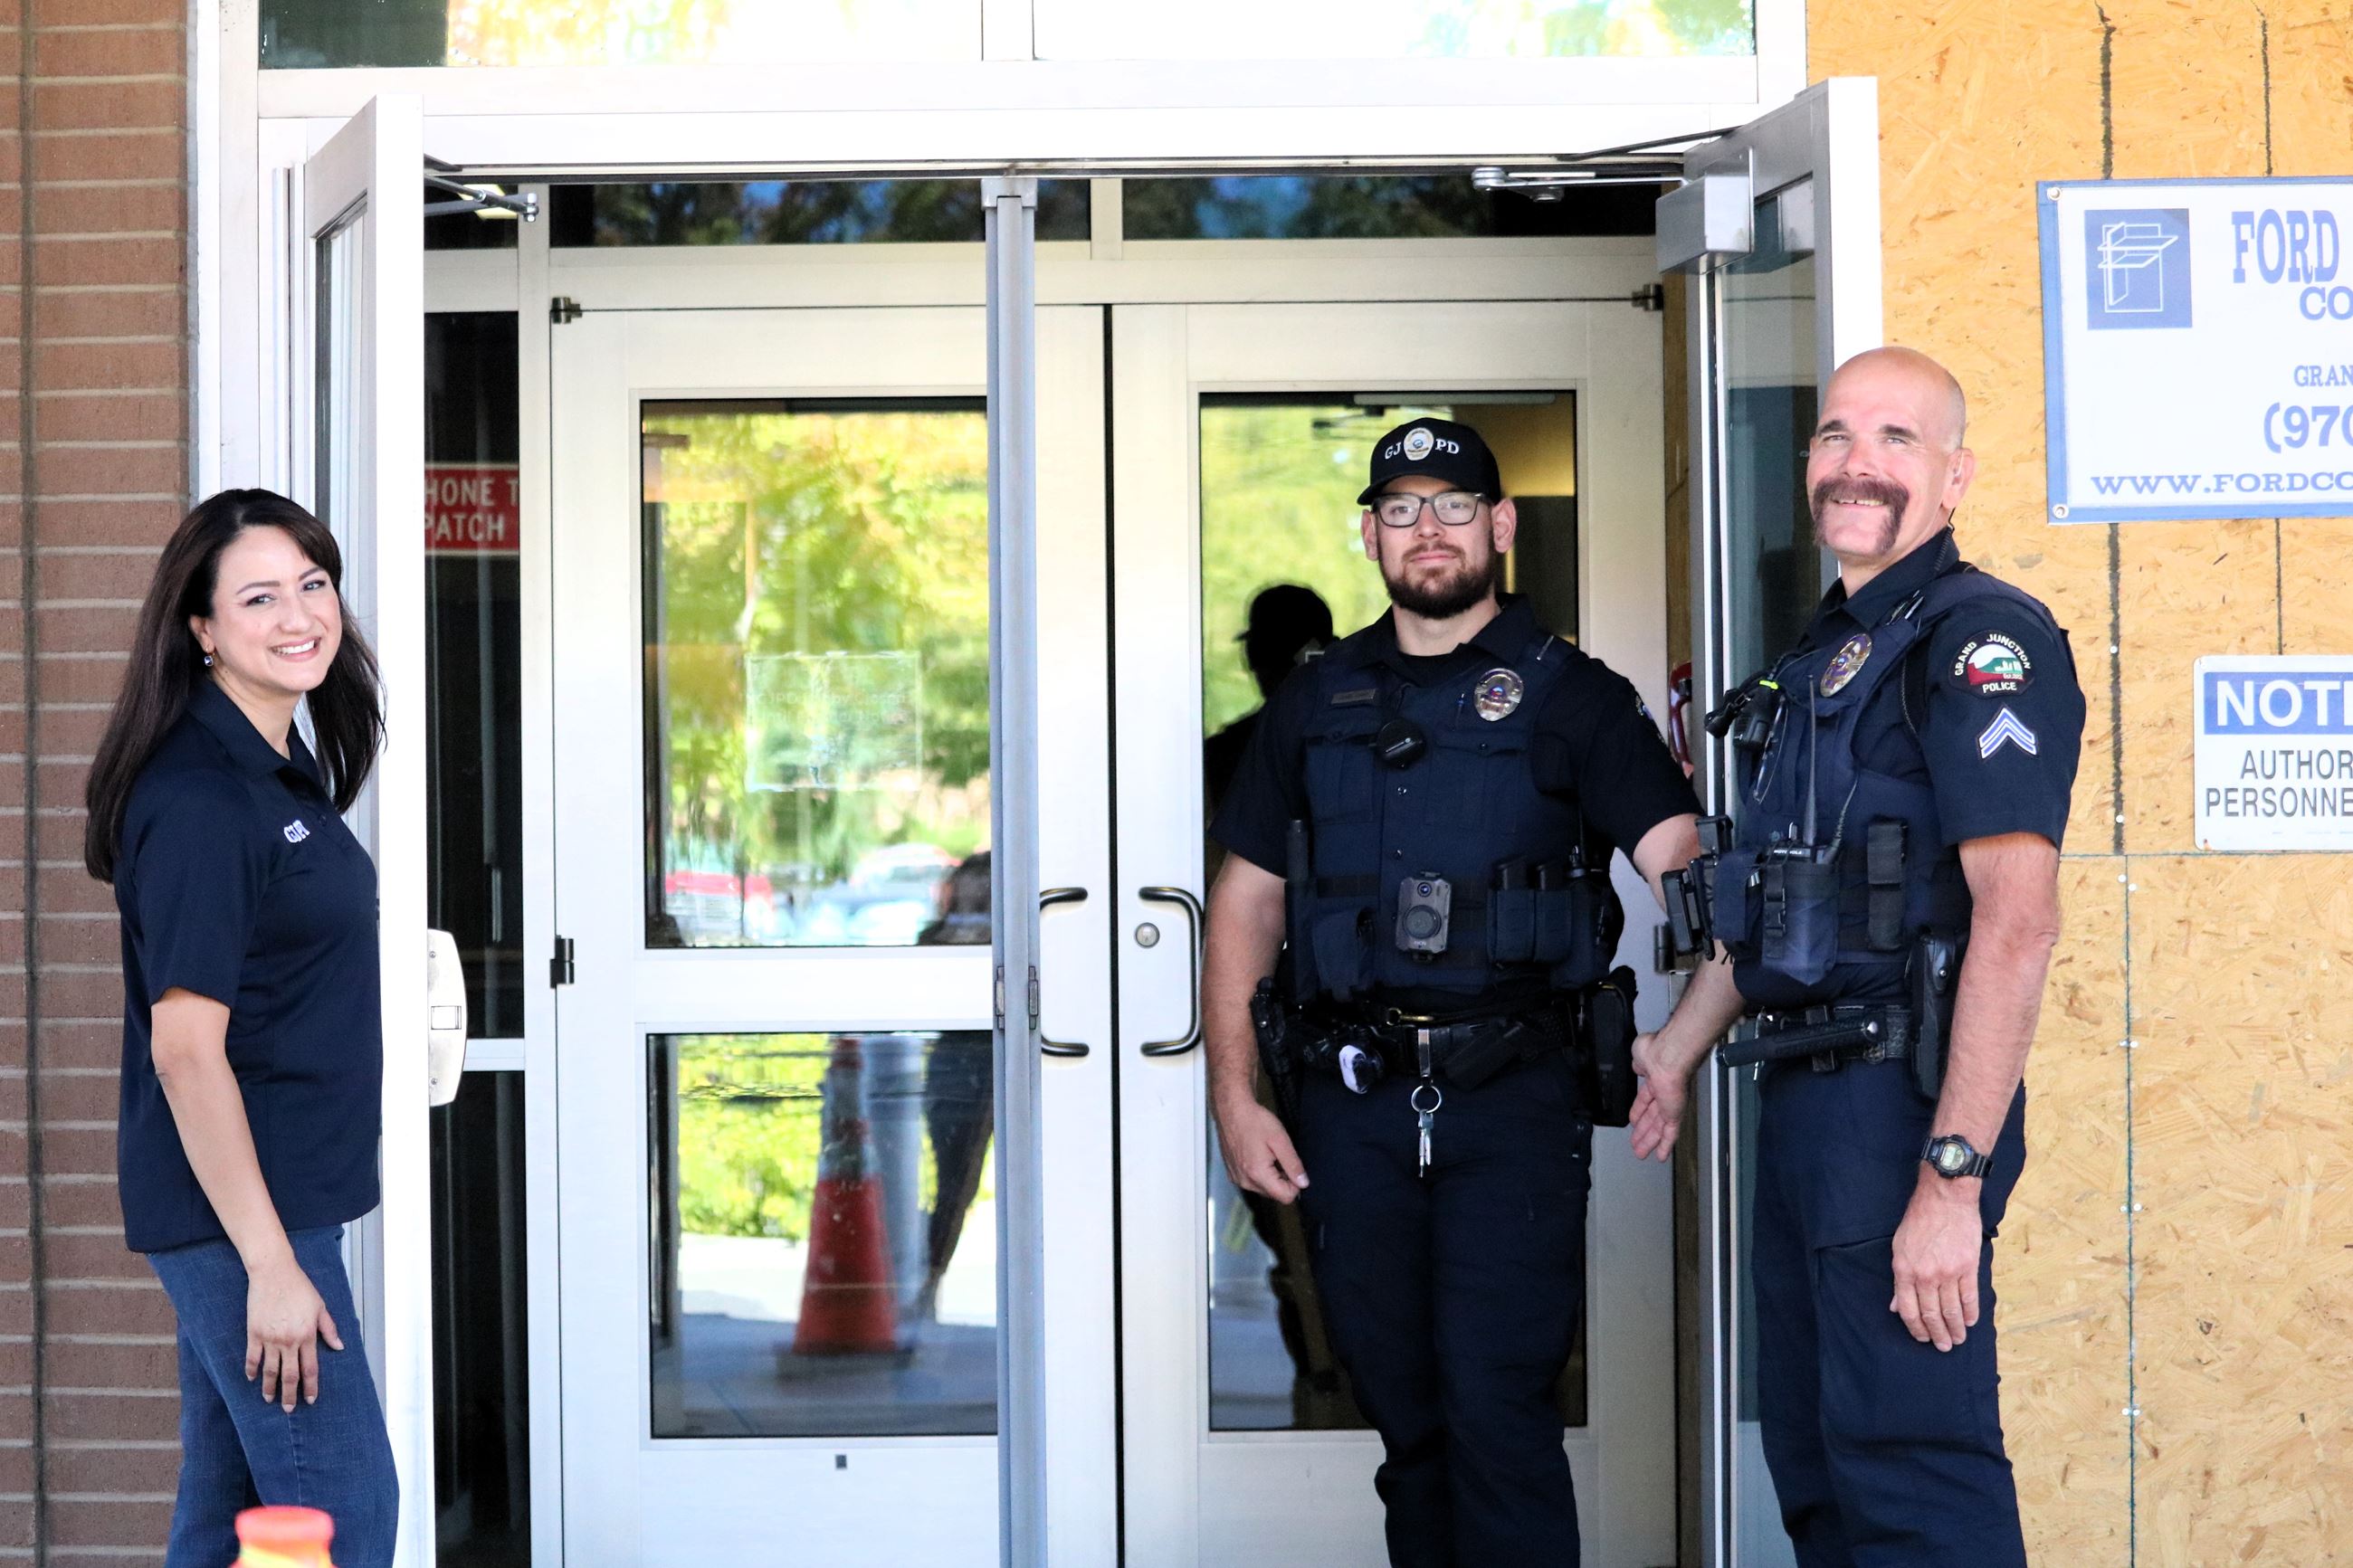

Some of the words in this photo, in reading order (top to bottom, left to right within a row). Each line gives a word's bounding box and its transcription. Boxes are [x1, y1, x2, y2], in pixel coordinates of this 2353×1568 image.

[2231, 208, 2339, 284] FORD
[2300, 285, 2353, 320] CO
[2293, 364, 2353, 387] GRAN
[1385, 442, 1401, 460] GJ
[1436, 439, 1459, 454] PD
[1955, 641, 1977, 676] GRAND
[1986, 634, 2031, 670] JUNCTION
[1983, 682, 2016, 693] POLICE
[2240, 749, 2353, 780] AUTHOR
[2205, 787, 2353, 818] PERSONNE
